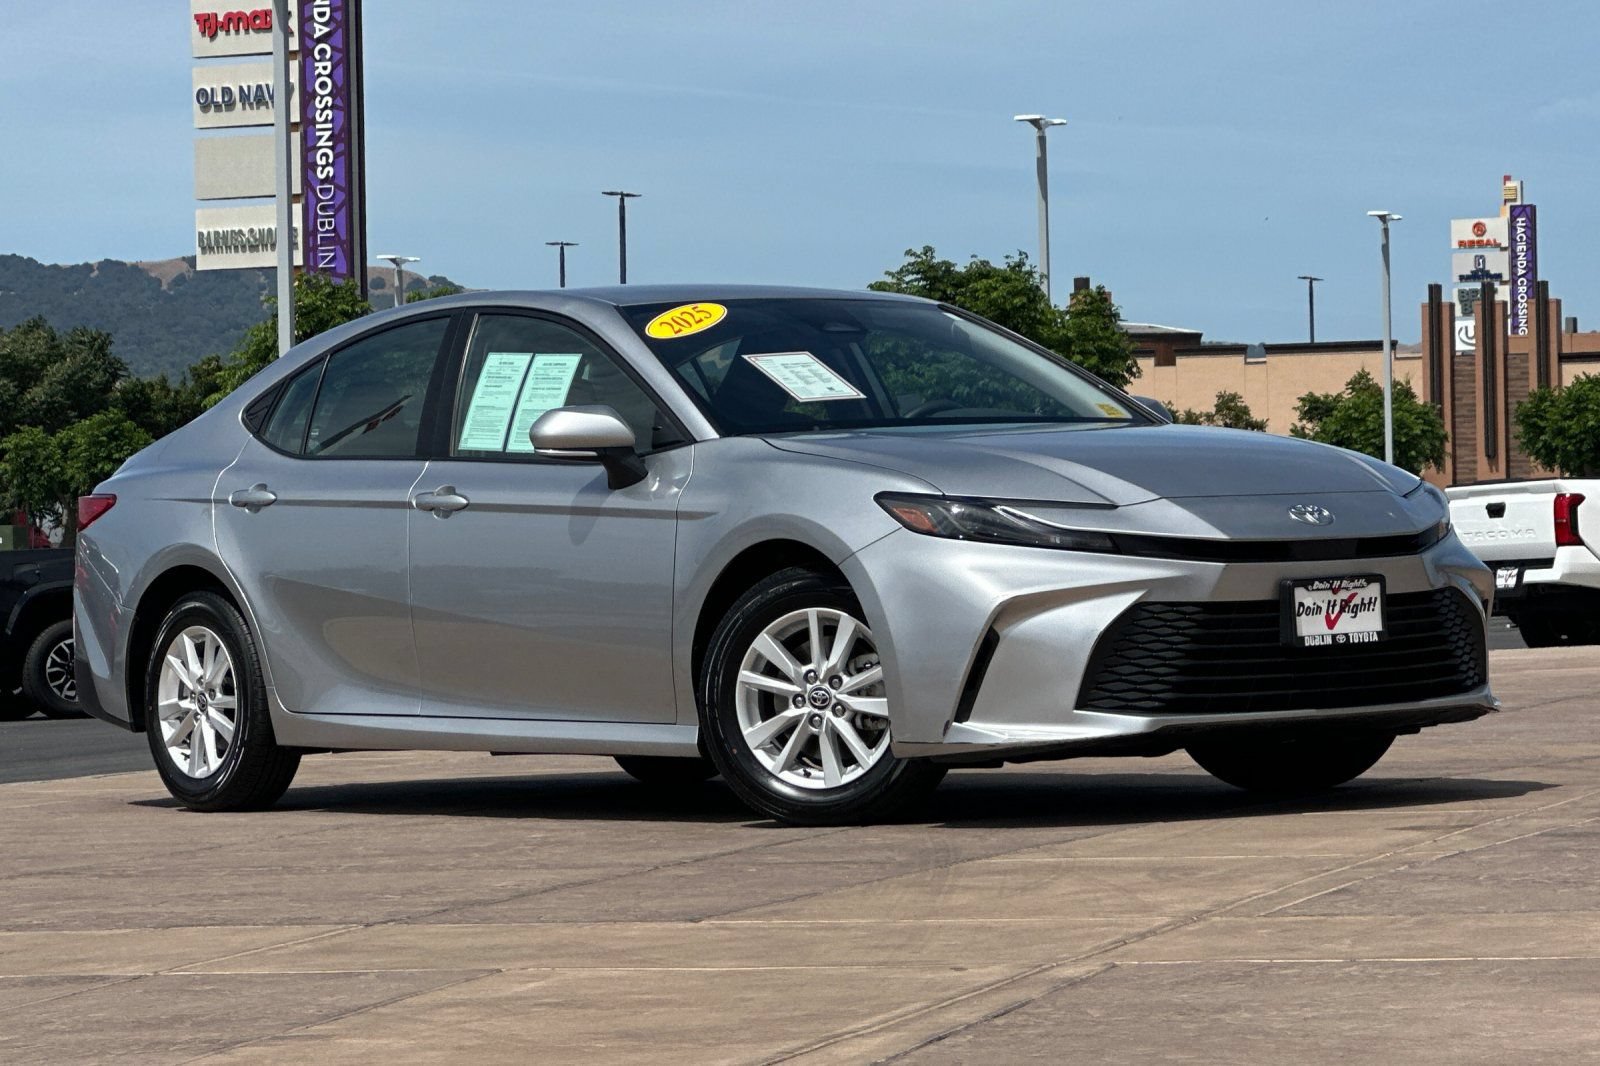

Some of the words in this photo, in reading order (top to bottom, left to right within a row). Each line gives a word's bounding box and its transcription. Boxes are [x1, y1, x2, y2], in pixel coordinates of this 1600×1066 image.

[195, 85, 235, 107] OLD
[239, 83, 275, 104] NAV
[314, 43, 334, 180] CROSSINGS
[316, 184, 337, 269] DUBLIN
[1457, 239, 1502, 249] REGAL
[1515, 217, 1527, 276] HACIENDA
[659, 305, 713, 335] 2025
[1463, 528, 1537, 541] TACOMA
[1296, 600, 1325, 618] Doin'
[1326, 599, 1338, 615] It
[1304, 634, 1333, 647] DUBLIN
[1348, 631, 1379, 644] TOYOTA
